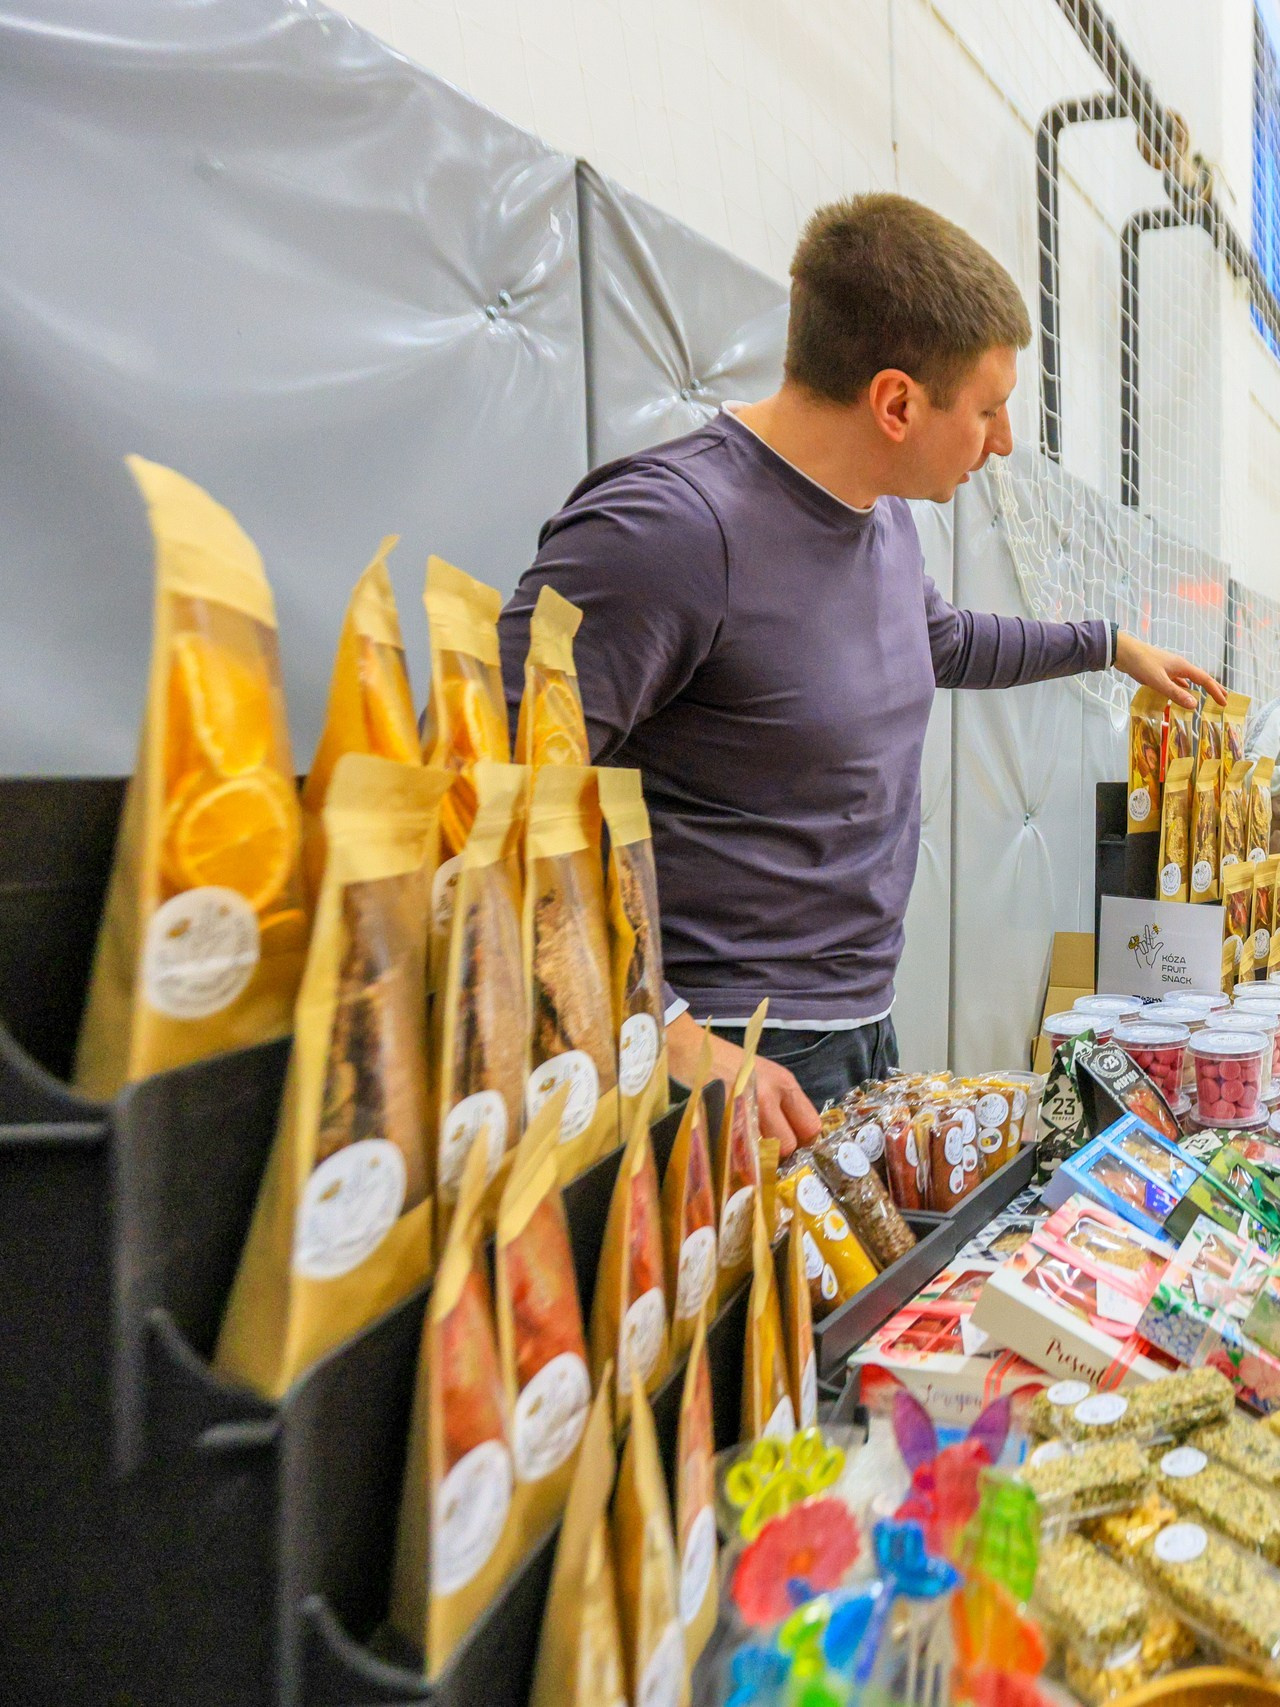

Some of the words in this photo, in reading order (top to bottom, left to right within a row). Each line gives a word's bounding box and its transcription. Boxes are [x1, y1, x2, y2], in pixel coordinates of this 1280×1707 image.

[1162, 953, 1186, 964] KÓZA
[1161, 964, 1187, 974] FRUIT
[1161, 974, 1192, 985] SNACK
[1052, 1098, 1076, 1115] 23
